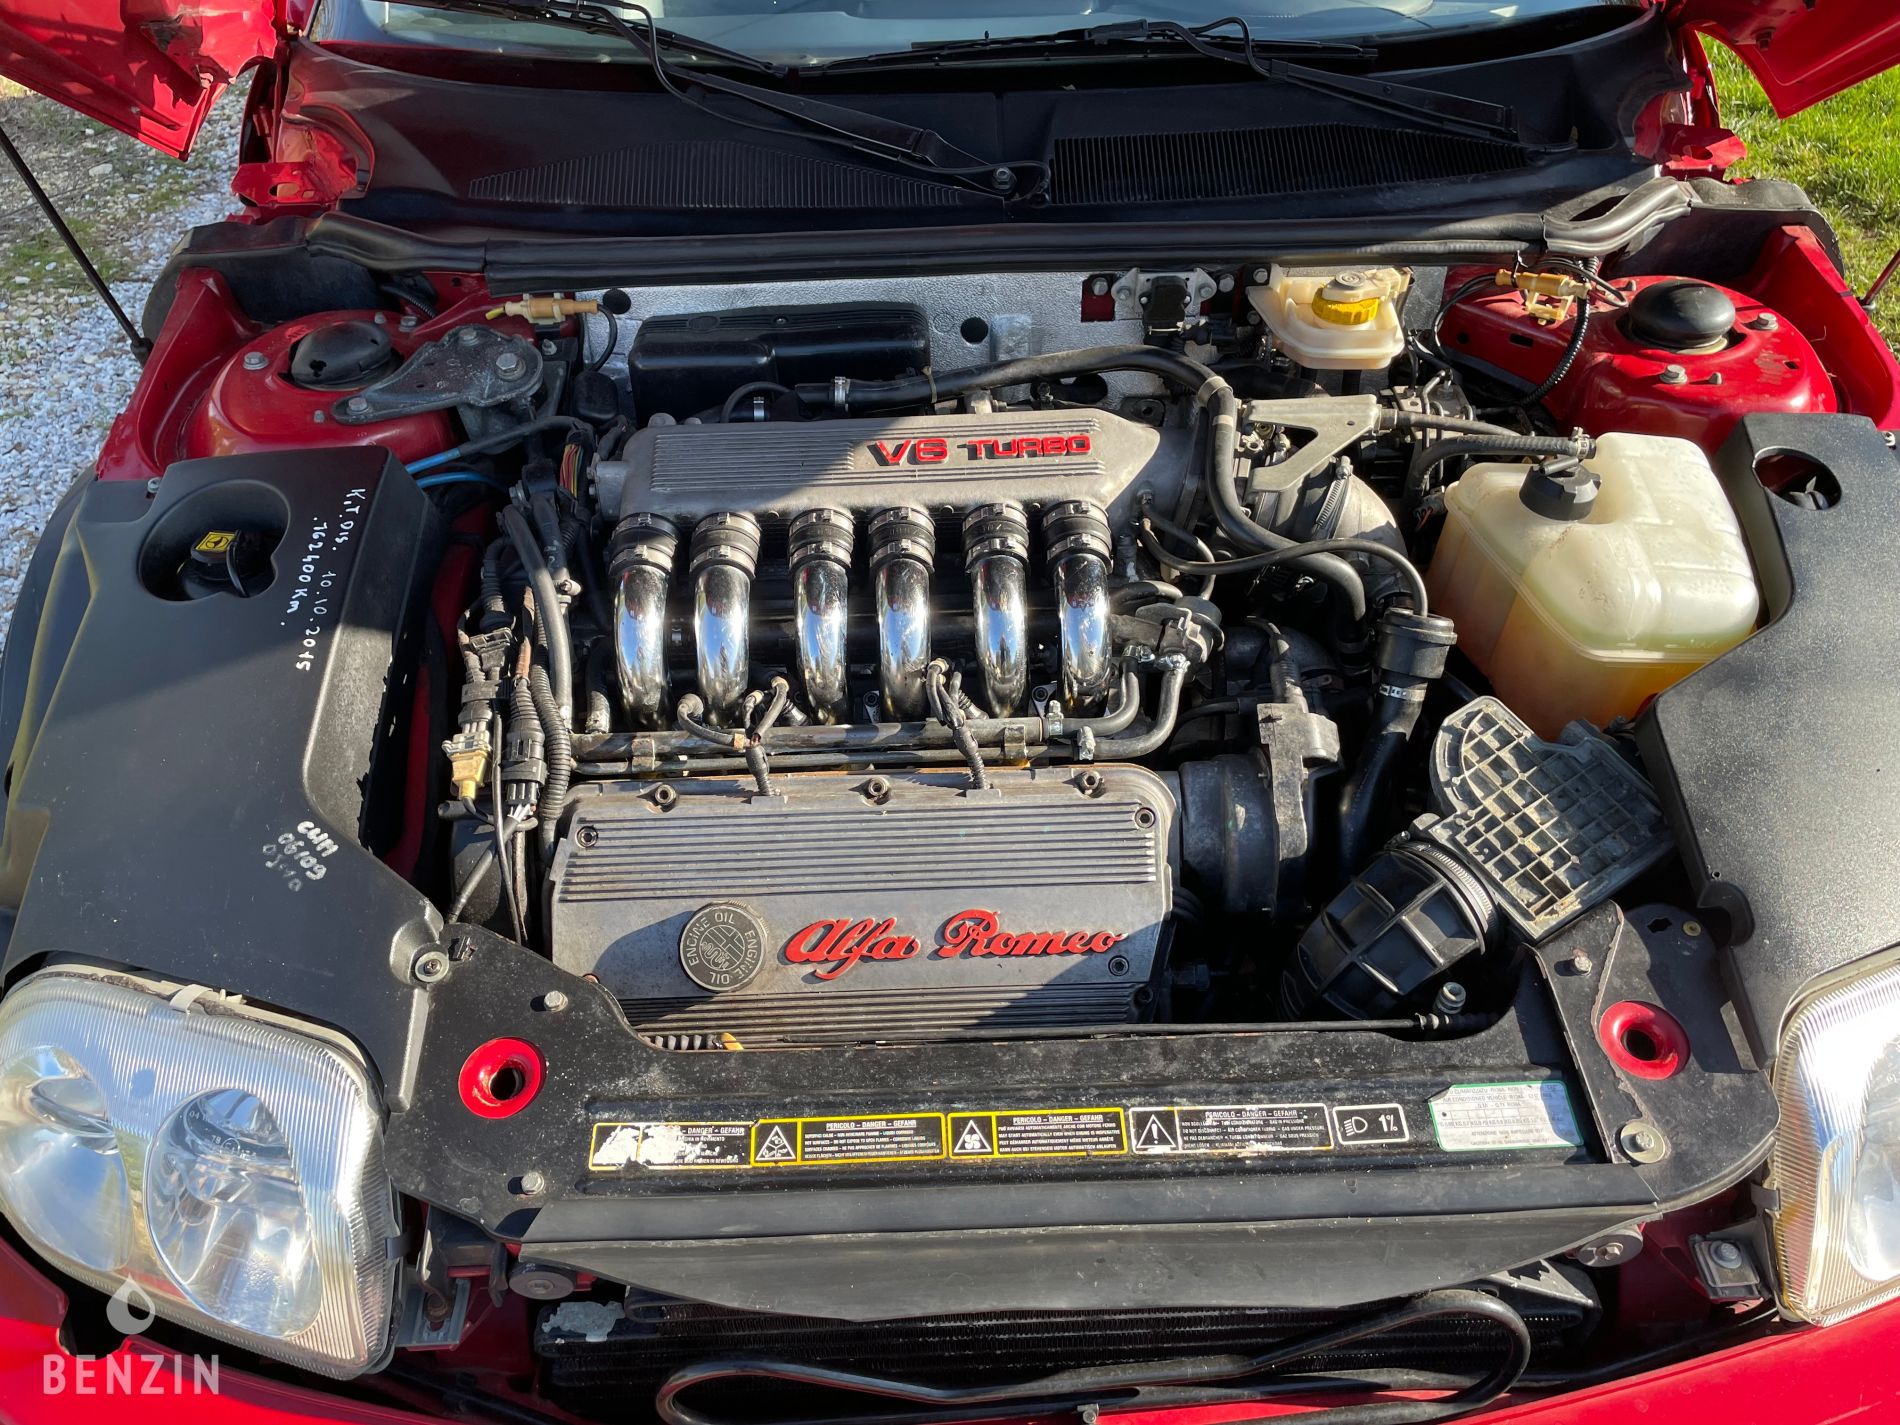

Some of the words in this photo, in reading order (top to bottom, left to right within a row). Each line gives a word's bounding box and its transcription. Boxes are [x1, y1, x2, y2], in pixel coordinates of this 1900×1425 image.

[876, 438, 948, 465] V6
[968, 435, 1092, 460] TURBO
[686, 917, 710, 966] ENGINE
[714, 912, 735, 924] OIL
[733, 930, 758, 979] ENGINE
[784, 917, 921, 980] Alfa
[938, 908, 1129, 958] Romeo
[710, 972, 730, 984] OIL
[1378, 1114, 1398, 1132] 1%
